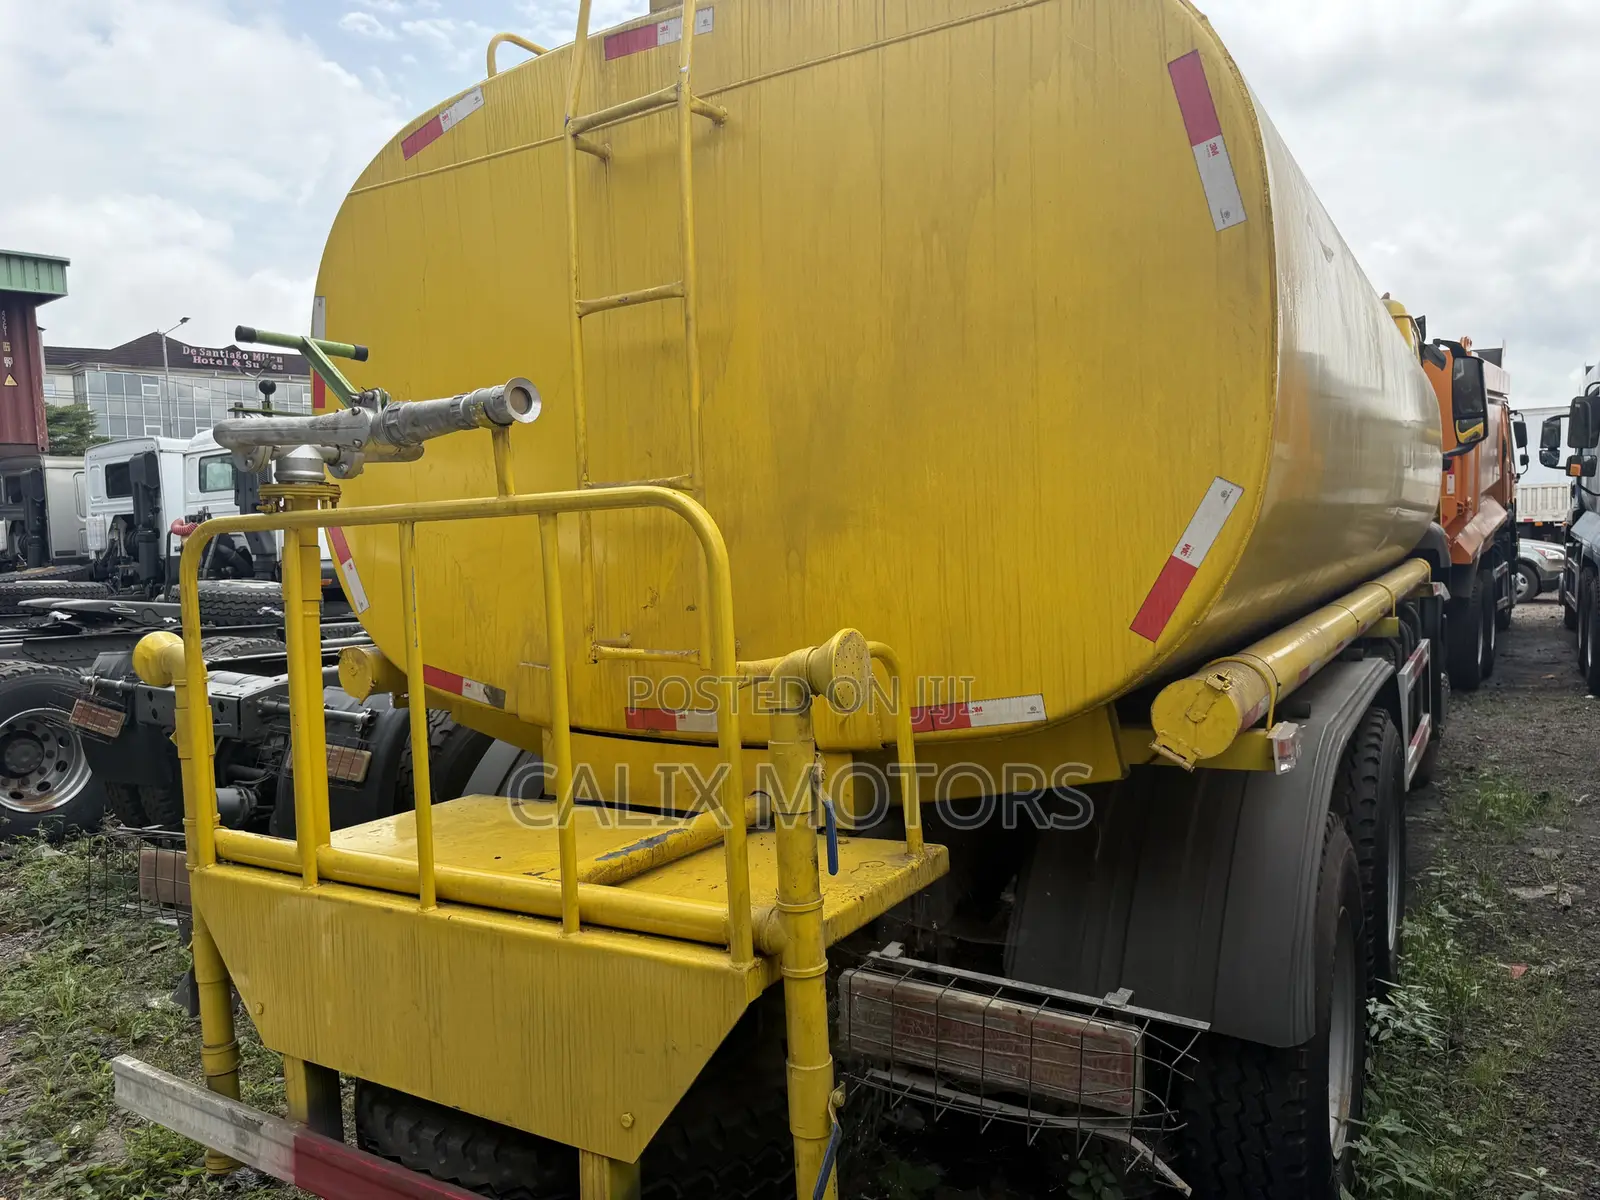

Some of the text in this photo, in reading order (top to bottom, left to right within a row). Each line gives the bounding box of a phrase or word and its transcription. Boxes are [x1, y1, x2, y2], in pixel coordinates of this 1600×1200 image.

[1209, 142, 1219, 156] 3M
[182, 346, 197, 355] De
[200, 348, 248, 359] Santiago
[193, 356, 284, 371] Hotel & Sues
[1180, 543, 1192, 557] 3M
